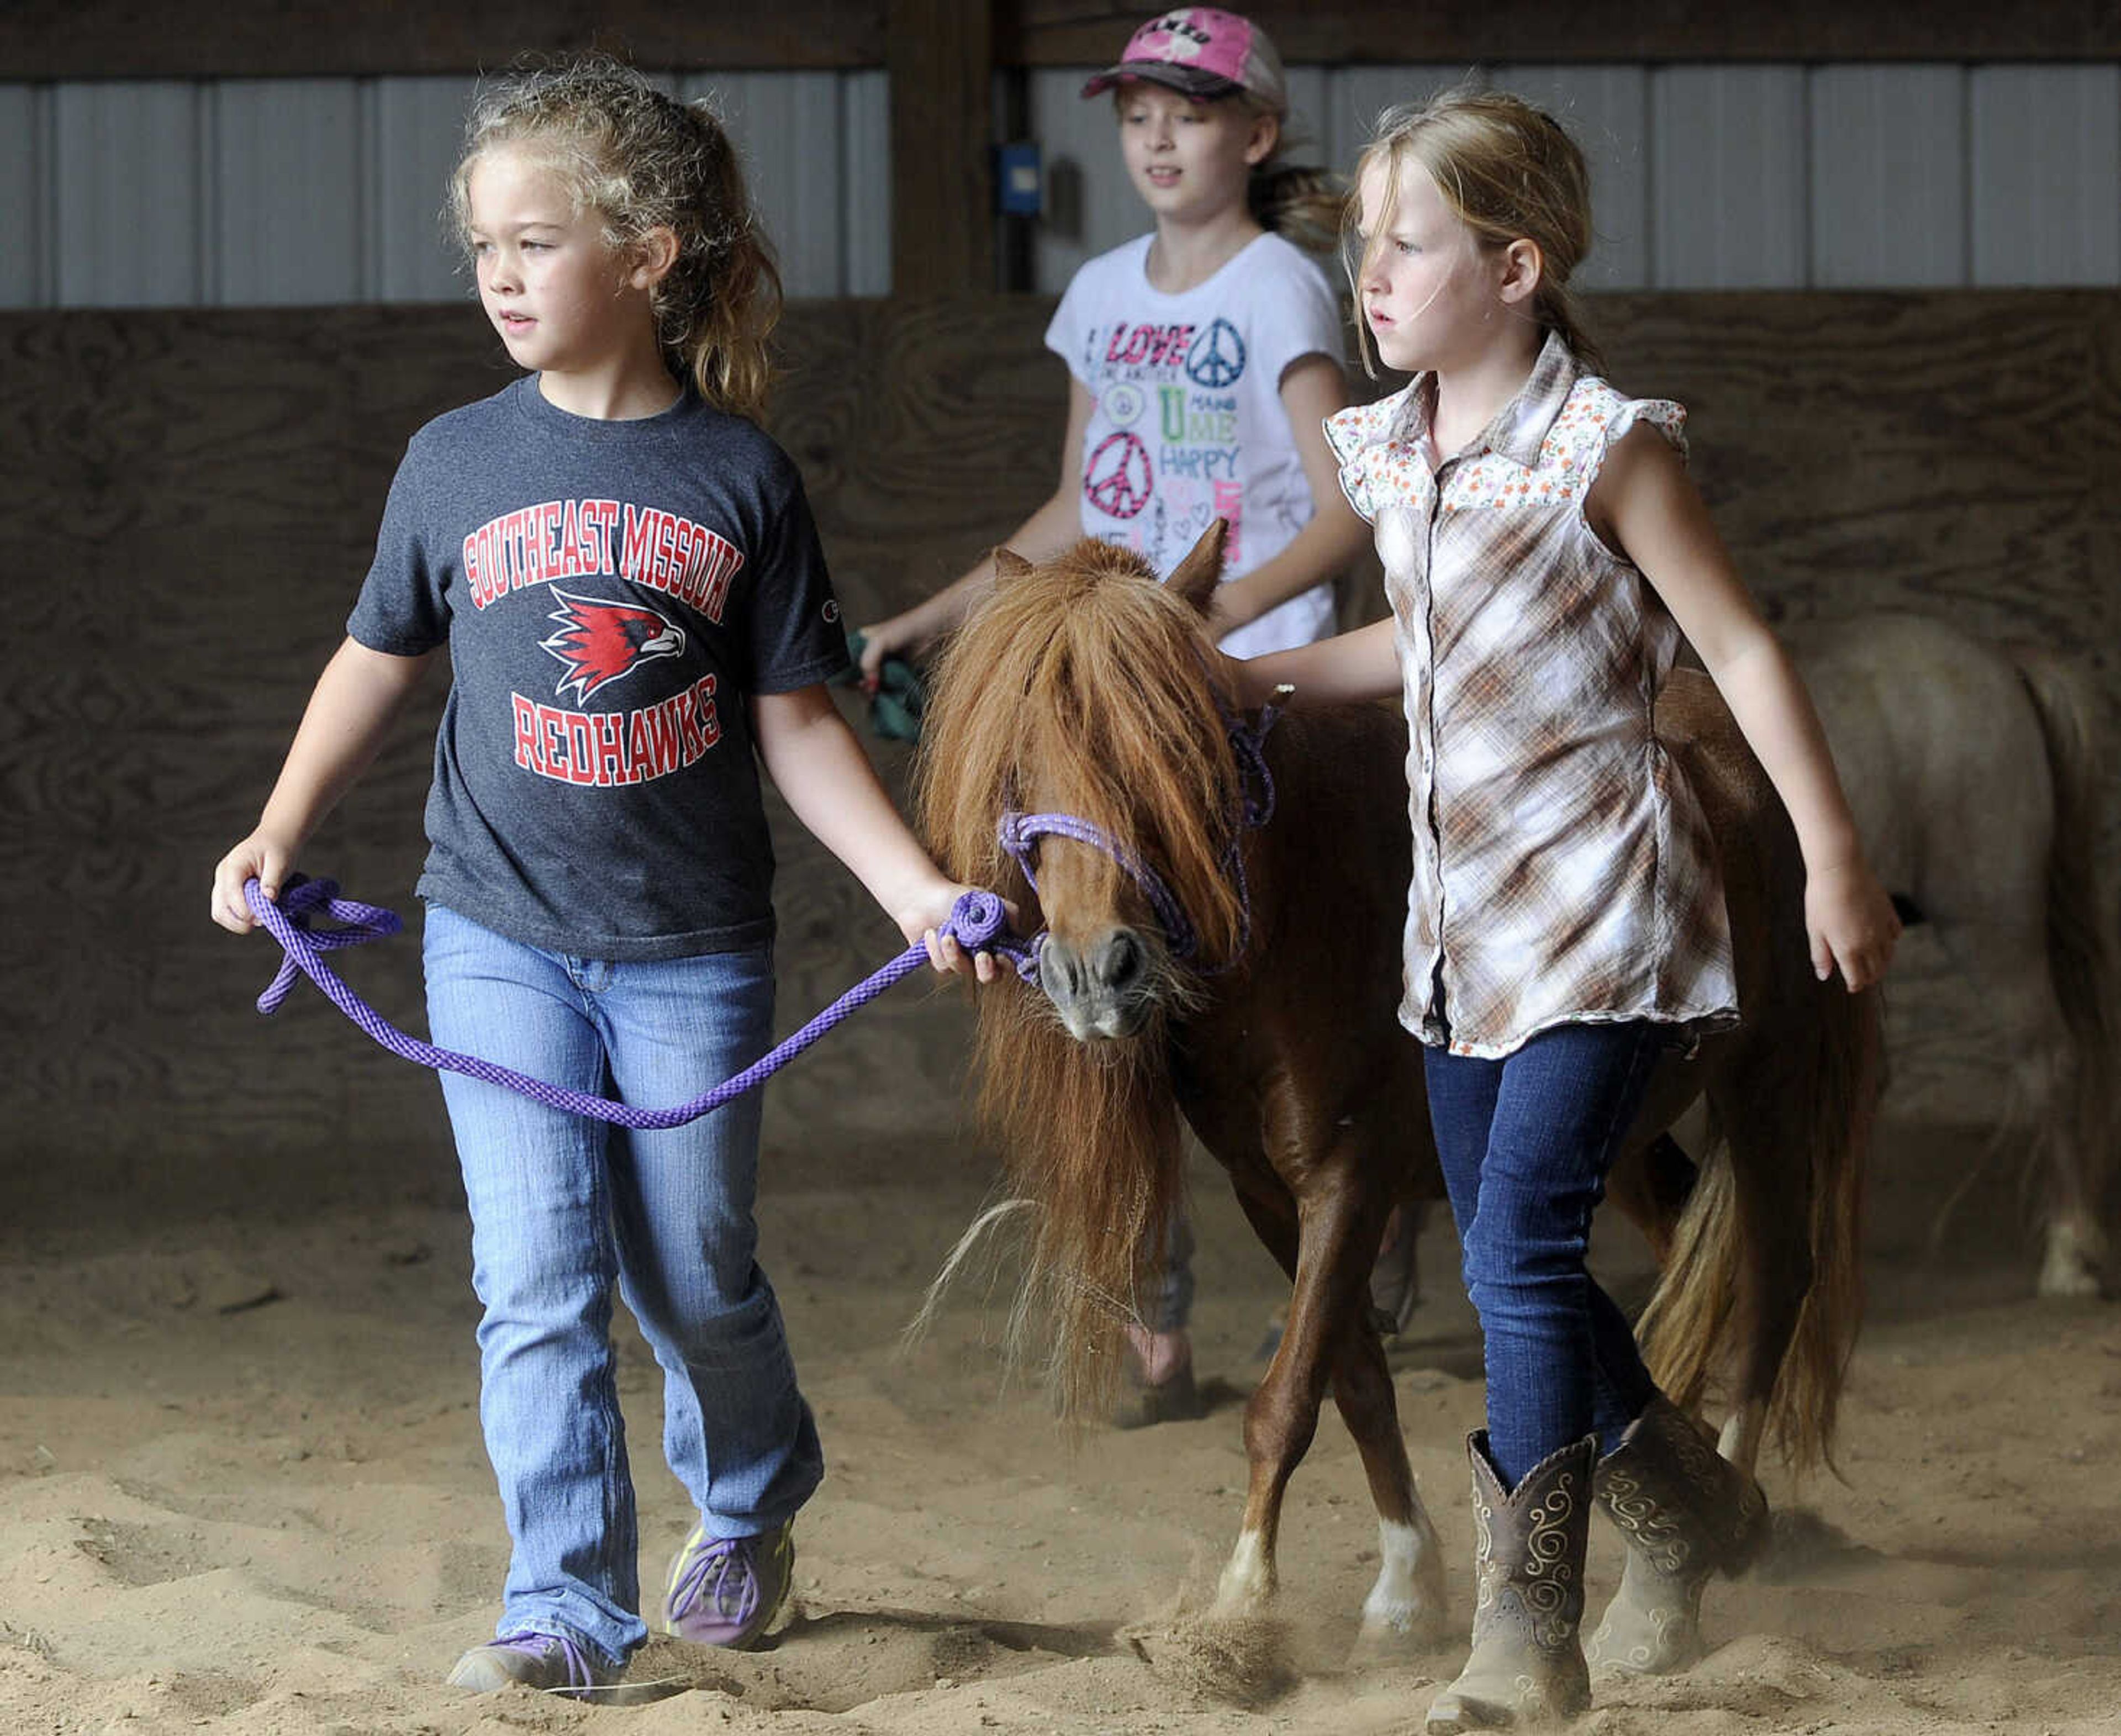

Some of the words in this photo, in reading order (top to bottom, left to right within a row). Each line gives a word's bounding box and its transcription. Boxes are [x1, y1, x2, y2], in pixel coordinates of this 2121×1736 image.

[1106, 323, 1195, 367] LOVE
[1158, 384, 1187, 444] U
[1189, 413, 1238, 444] ME
[1160, 445, 1242, 480] HAPPY
[463, 499, 620, 611] SOUTHEAST
[620, 502, 745, 625] MISSOURI
[511, 673, 719, 787] REDHAWKS
